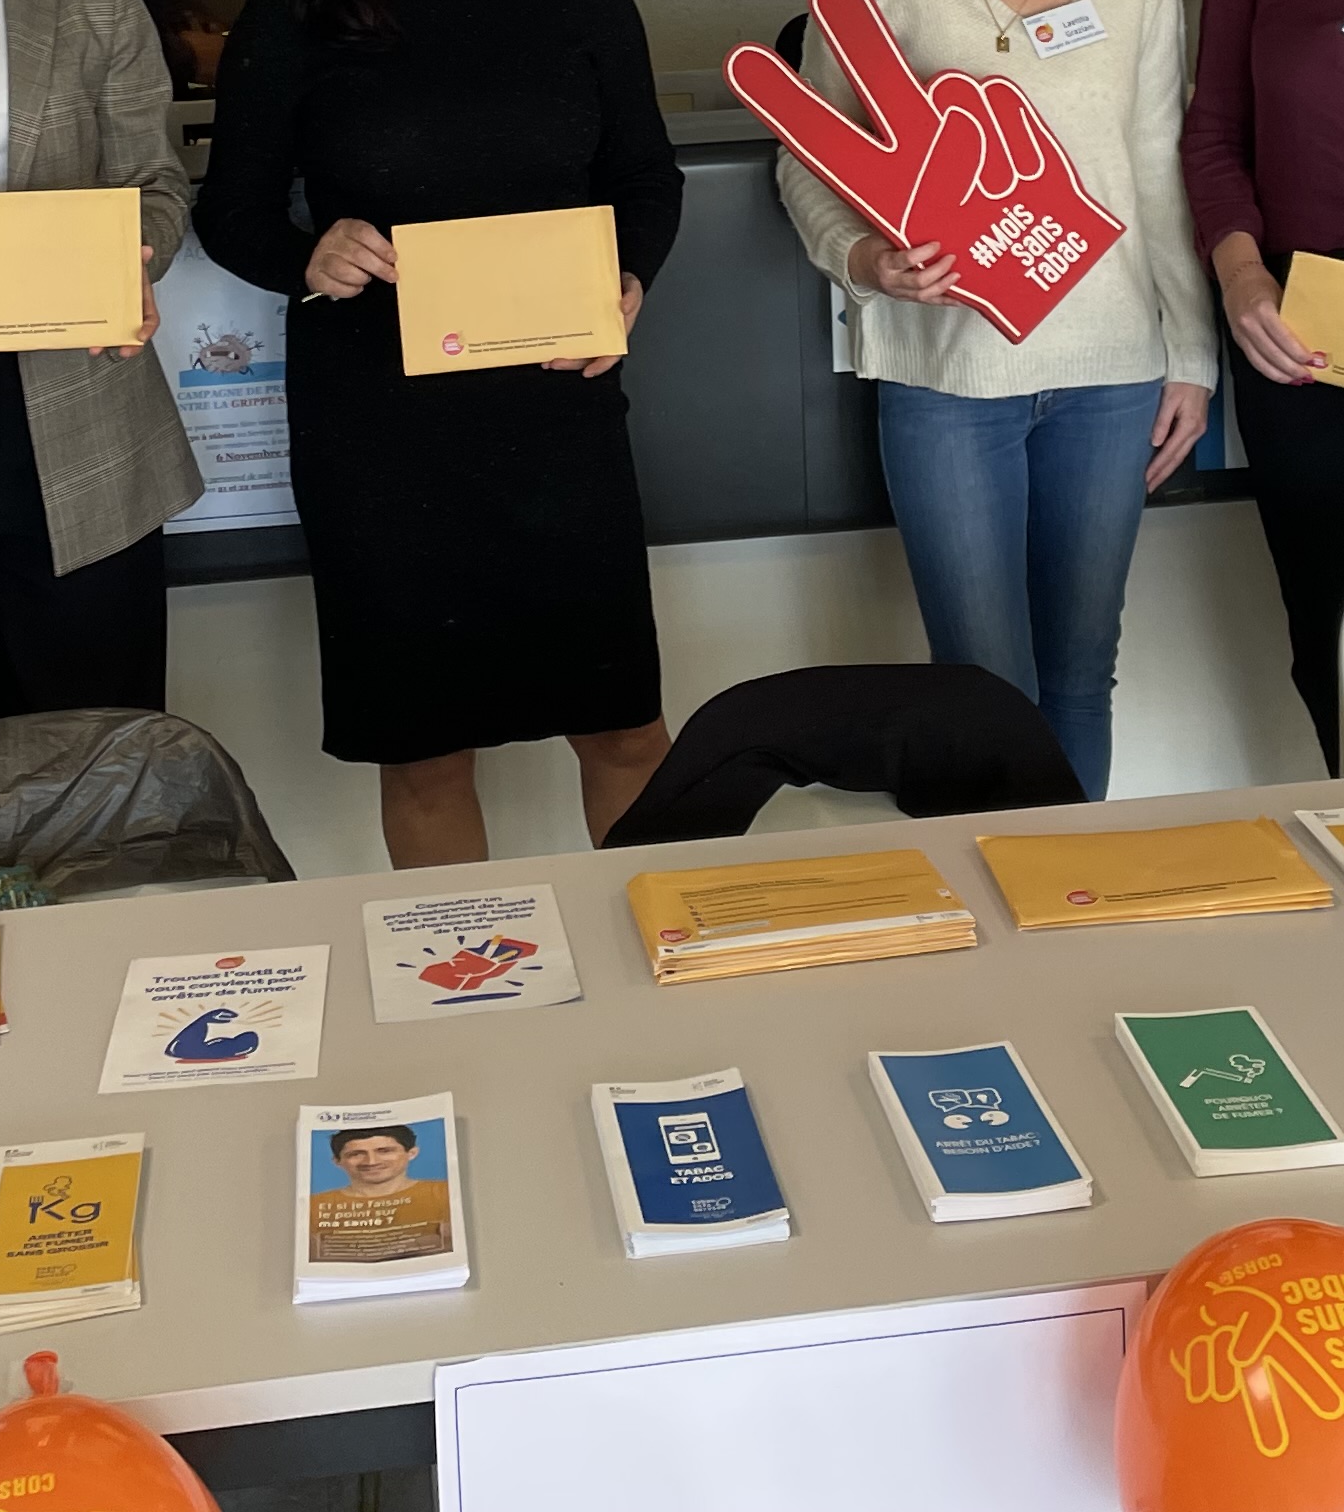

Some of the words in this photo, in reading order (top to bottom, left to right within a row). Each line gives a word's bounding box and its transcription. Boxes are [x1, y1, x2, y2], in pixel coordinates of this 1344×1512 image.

[968, 203, 1035, 269] #Mois
[1010, 215, 1064, 267] Sans
[1024, 231, 1089, 292] Tabac
[177, 387, 242, 401] CAMPAGNE
[213, 400, 230, 410] LA
[231, 396, 275, 409] GRIPPE
[415, 898, 483, 909] Consulter
[383, 904, 475, 921] professionnel
[414, 919, 472, 930] chances
[453, 923, 495, 932] fumer
[152, 971, 221, 985] Trouvez
[276, 965, 304, 978] qui
[144, 984, 186, 994] vous
[188, 976, 266, 991] convient
[267, 974, 308, 987] pour
[151, 989, 212, 1002] arrêter
[215, 988, 238, 997] de
[240, 985, 297, 995] fumer.
[1204, 1094, 1273, 1105] POURQUOI
[1218, 1102, 1269, 1112] ARRÊTER
[1212, 1111, 1231, 1120] DE
[1231, 1109, 1275, 1119] FUMER
[935, 1138, 972, 1149] ARRÊT
[974, 1137, 994, 1147] DU
[942, 1144, 991, 1155] BESOIN
[674, 1165, 725, 1177] TABAC
[670, 1176, 690, 1186] ET
[691, 1171, 734, 1184] ADOS
[28, 1196, 103, 1225] Kg
[318, 1202, 333, 1211] Et
[336, 1201, 348, 1211] si
[351, 1201, 365, 1212] je
[367, 1196, 413, 1209] faisais
[318, 1210, 331, 1220] le
[334, 1209, 372, 1221] point
[374, 1208, 398, 1217] sur
[318, 1220, 341, 1229] ma
[343, 1218, 383, 1228] santé
[27, 1228, 94, 1242] ARRÊTER
[5, 1249, 45, 1258] SANS
[46, 1241, 110, 1255] GROSSIR
[23, 1241, 43, 1250] DE
[44, 1236, 95, 1249] FUMER
[1217, 1253, 1283, 1284] CORSE
